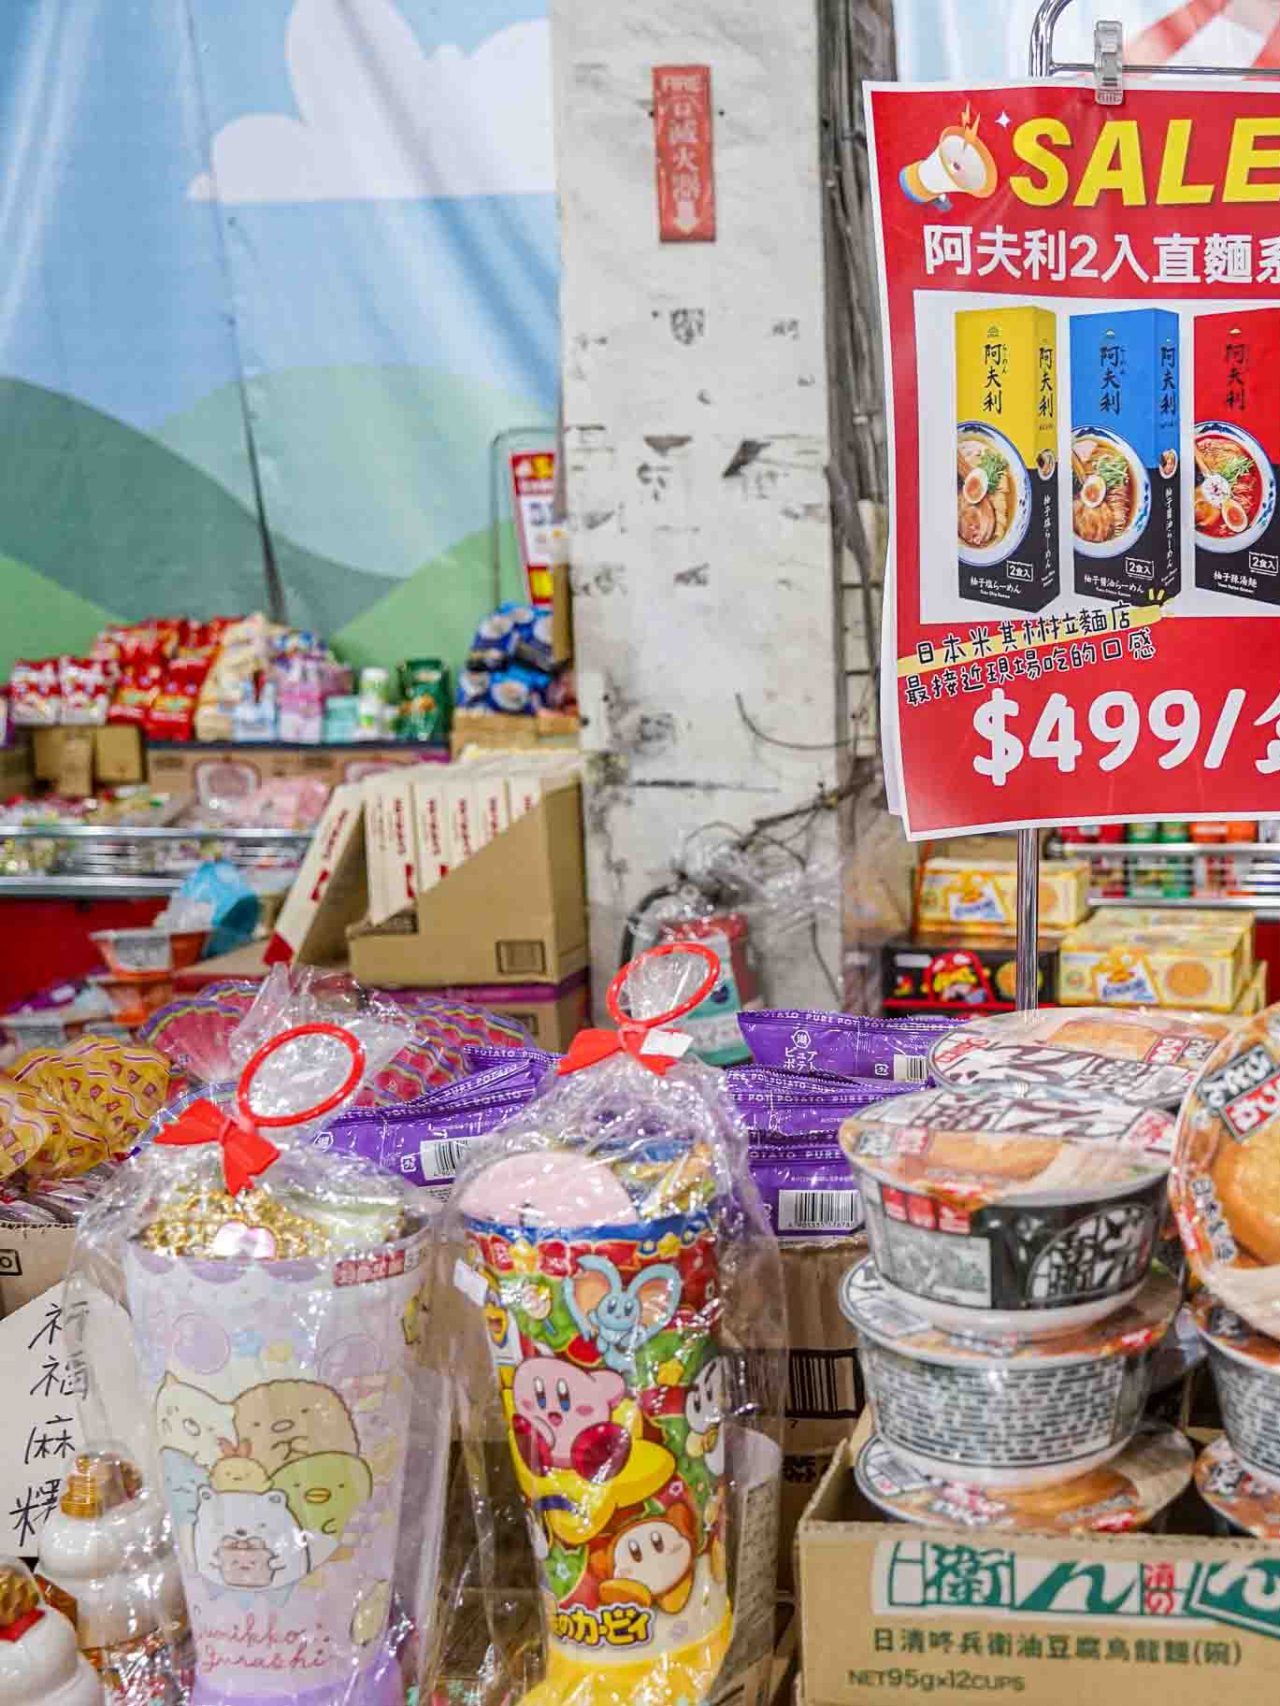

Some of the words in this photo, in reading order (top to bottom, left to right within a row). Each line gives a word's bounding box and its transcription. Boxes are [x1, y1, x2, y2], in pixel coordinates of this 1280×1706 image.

[982, 343, 1003, 415] 阿夫利
[1009, 565, 1031, 578] 2食入
[1129, 561, 1152, 576] 2食入
[1251, 558, 1276, 571] 2食入
[915, 601, 1131, 666] 日本米其林拉麵店
[904, 627, 1156, 706] 最接近現場吃的口感
